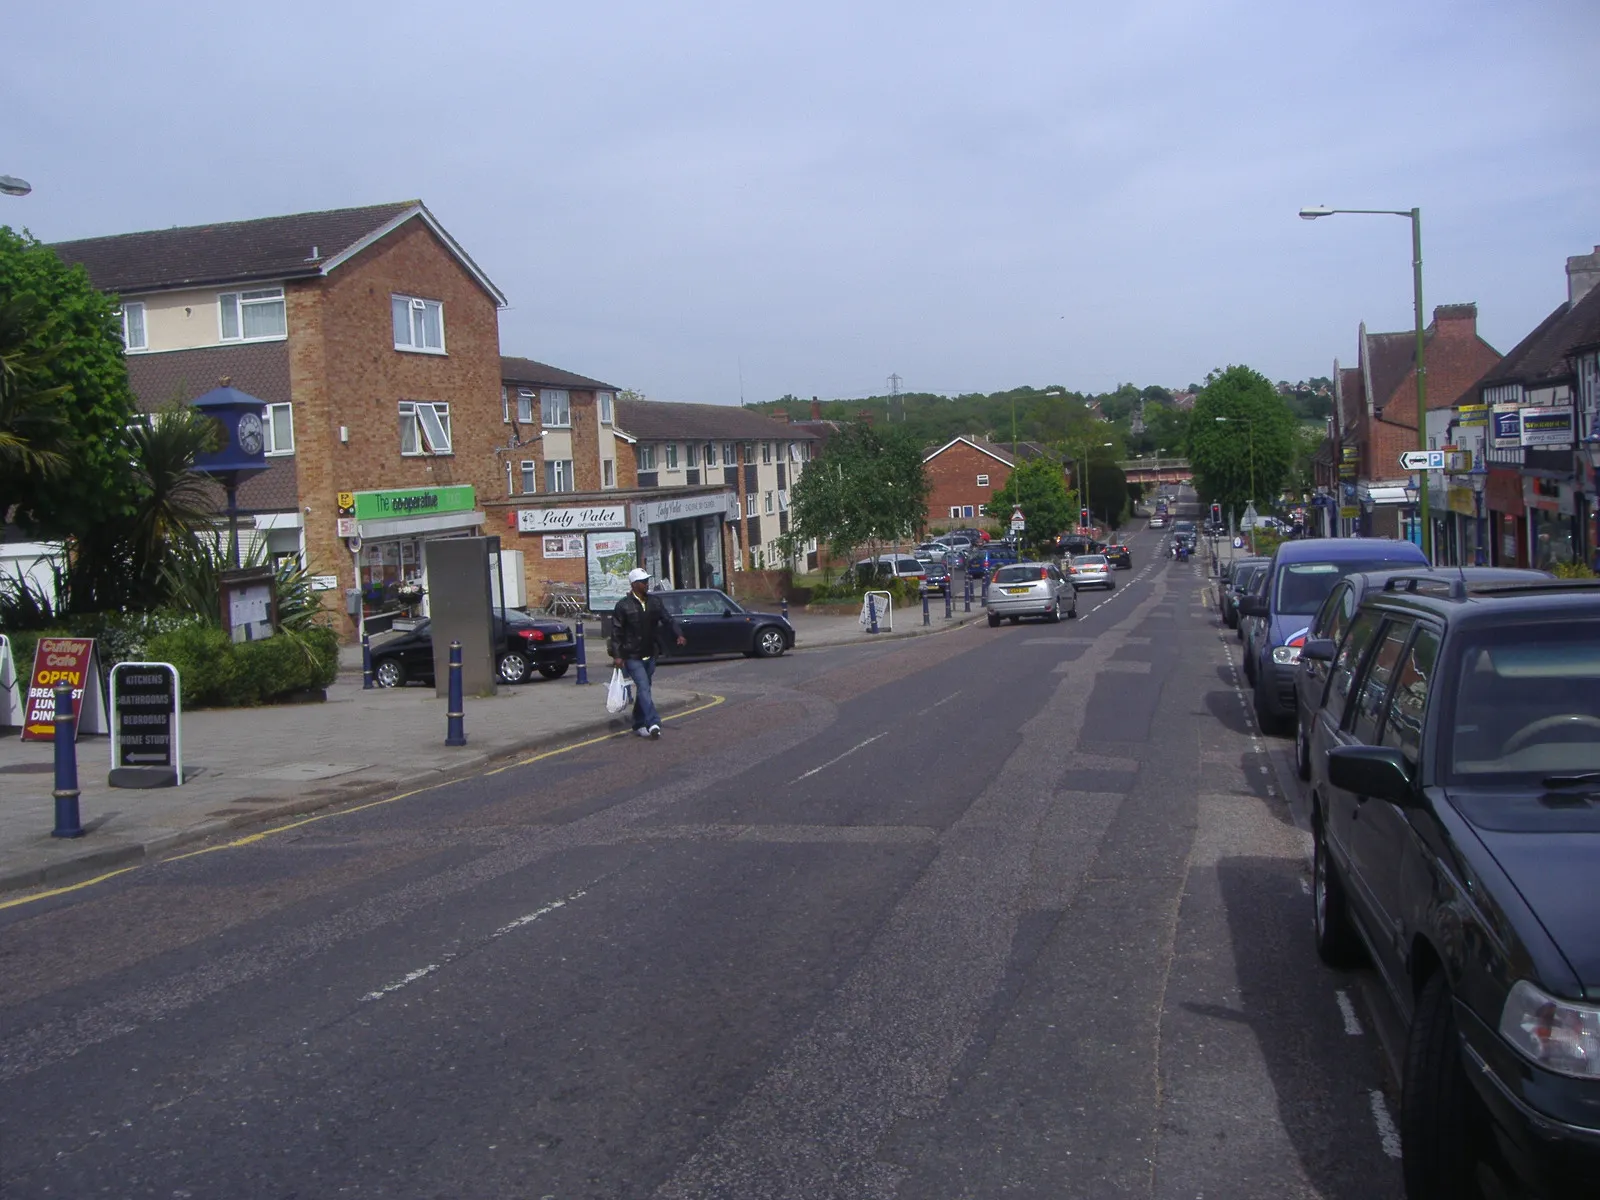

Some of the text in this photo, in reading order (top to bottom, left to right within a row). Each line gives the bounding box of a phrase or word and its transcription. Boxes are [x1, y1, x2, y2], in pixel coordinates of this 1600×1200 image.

[375, 493, 390, 513] The
[541, 508, 616, 528] Lady Valet
[37, 670, 80, 685] OPEN
[125, 674, 163, 685] KITCHENS
[30, 688, 83, 699] BREAST
[120, 694, 169, 705] BATHROOMS
[123, 714, 167, 725] BEDROOMS
[120, 734, 169, 745] HOME STUDY
